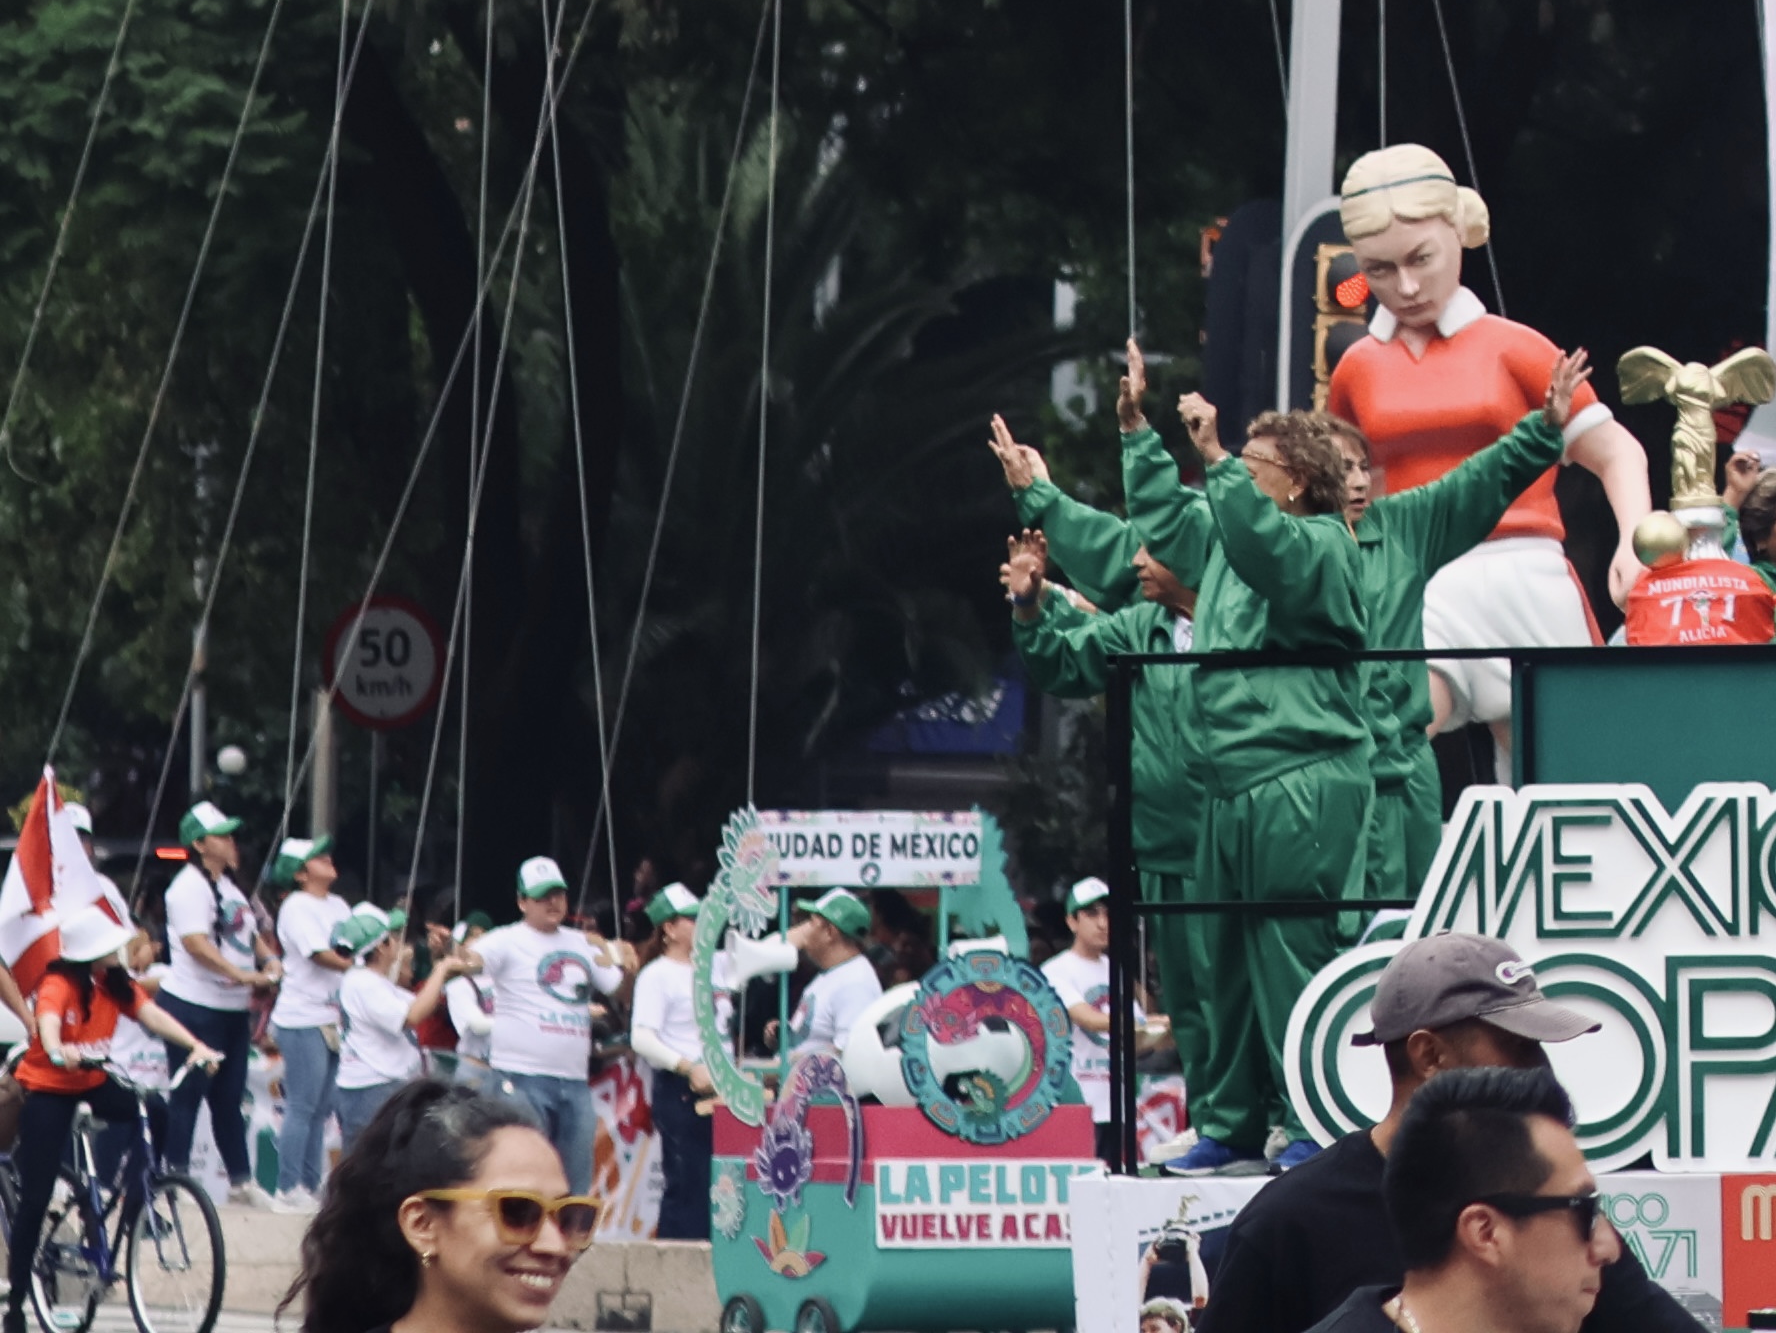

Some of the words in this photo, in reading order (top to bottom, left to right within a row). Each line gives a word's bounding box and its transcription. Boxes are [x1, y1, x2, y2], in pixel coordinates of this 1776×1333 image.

[1647, 576, 1750, 596] MUNDIALISTA
[360, 627, 411, 668] 50
[1679, 626, 1728, 644] ALICIA
[355, 674, 413, 697] km/h
[852, 833, 881, 859] DE
[879, 1164, 932, 1204] LA
[939, 1164, 1096, 1204] PELOT
[880, 1214, 992, 1241] VUELVE
[1001, 1214, 1018, 1241] A
[1024, 1214, 1071, 1241] CA
